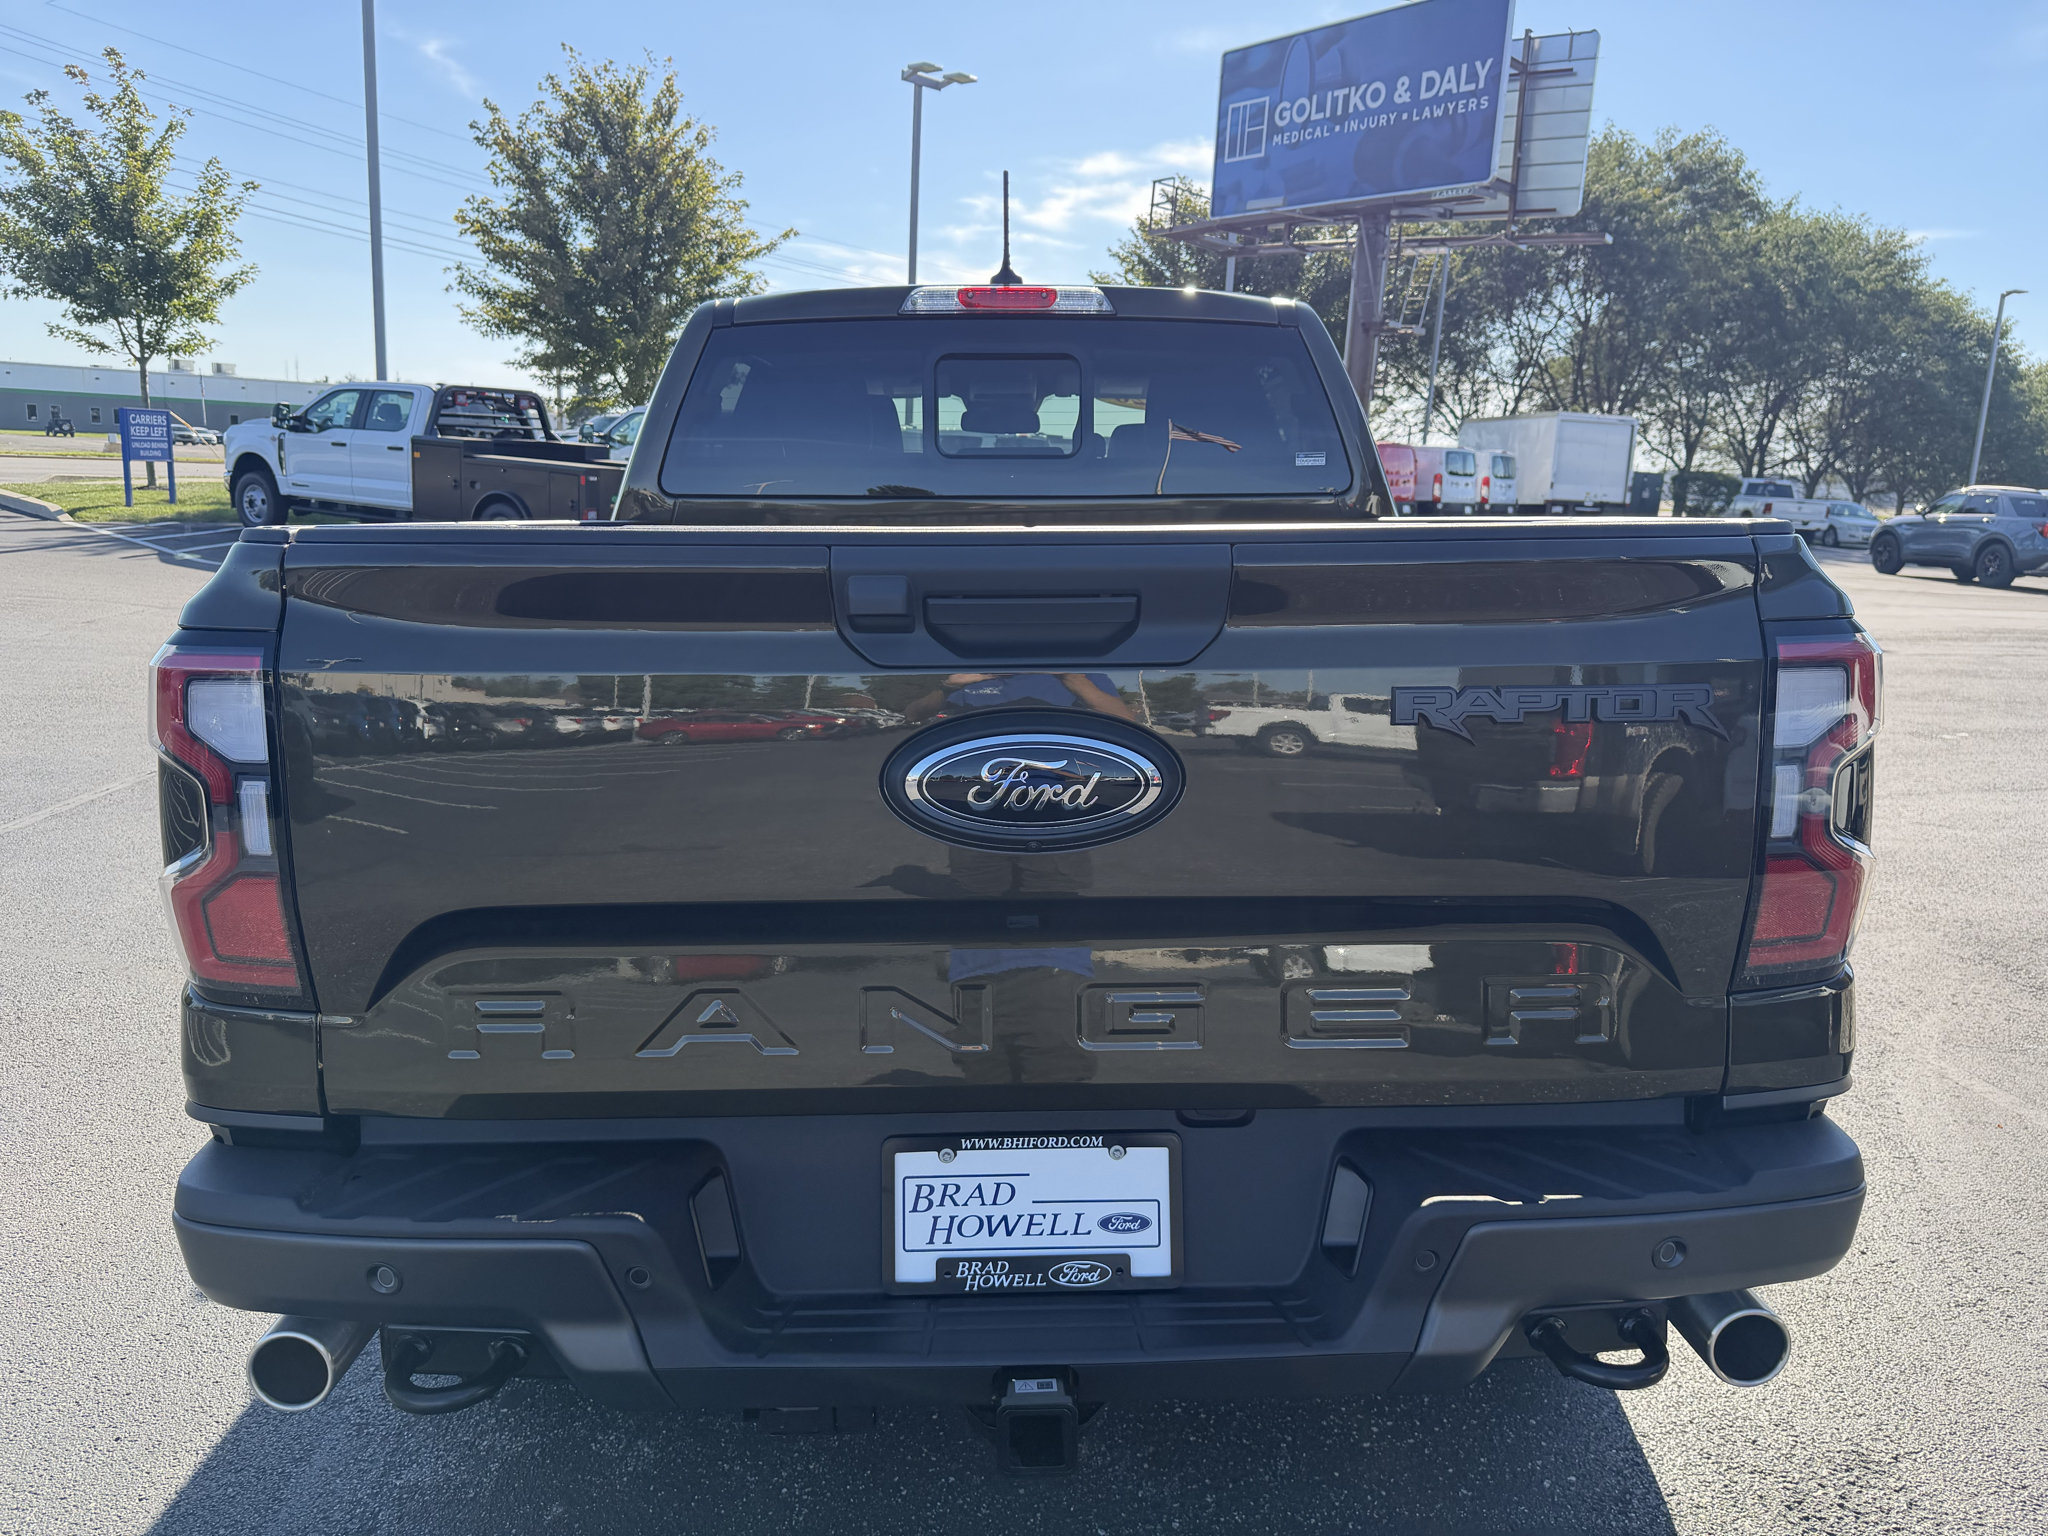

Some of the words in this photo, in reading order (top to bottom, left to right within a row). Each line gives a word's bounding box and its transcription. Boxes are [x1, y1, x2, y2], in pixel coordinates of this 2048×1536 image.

[1274, 81, 1386, 127] GOLITKO
[1393, 75, 1412, 104] &
[1420, 58, 1494, 100] DALY
[1272, 125, 1330, 146] MEDICAL
[1344, 112, 1398, 133] INJURY
[1412, 96, 1489, 121] LAWYERS
[130, 414, 167, 425] CARRIERS
[131, 426, 149, 436] KEEP
[151, 427, 167, 437] LEFT
[1391, 683, 1730, 746] RAPTOR
[967, 757, 1102, 811] Ford
[446, 978, 1617, 1059] RANGER
[961, 1136, 1104, 1149] WWW.BHIFORD.COM
[909, 1182, 1016, 1213] BRAD
[926, 1213, 1092, 1245] HOWELL
[1108, 1216, 1141, 1230] Ford
[956, 1261, 1009, 1277] BRAD
[964, 1273, 1047, 1291] HOWELL
[1059, 1263, 1101, 1282] Ford
